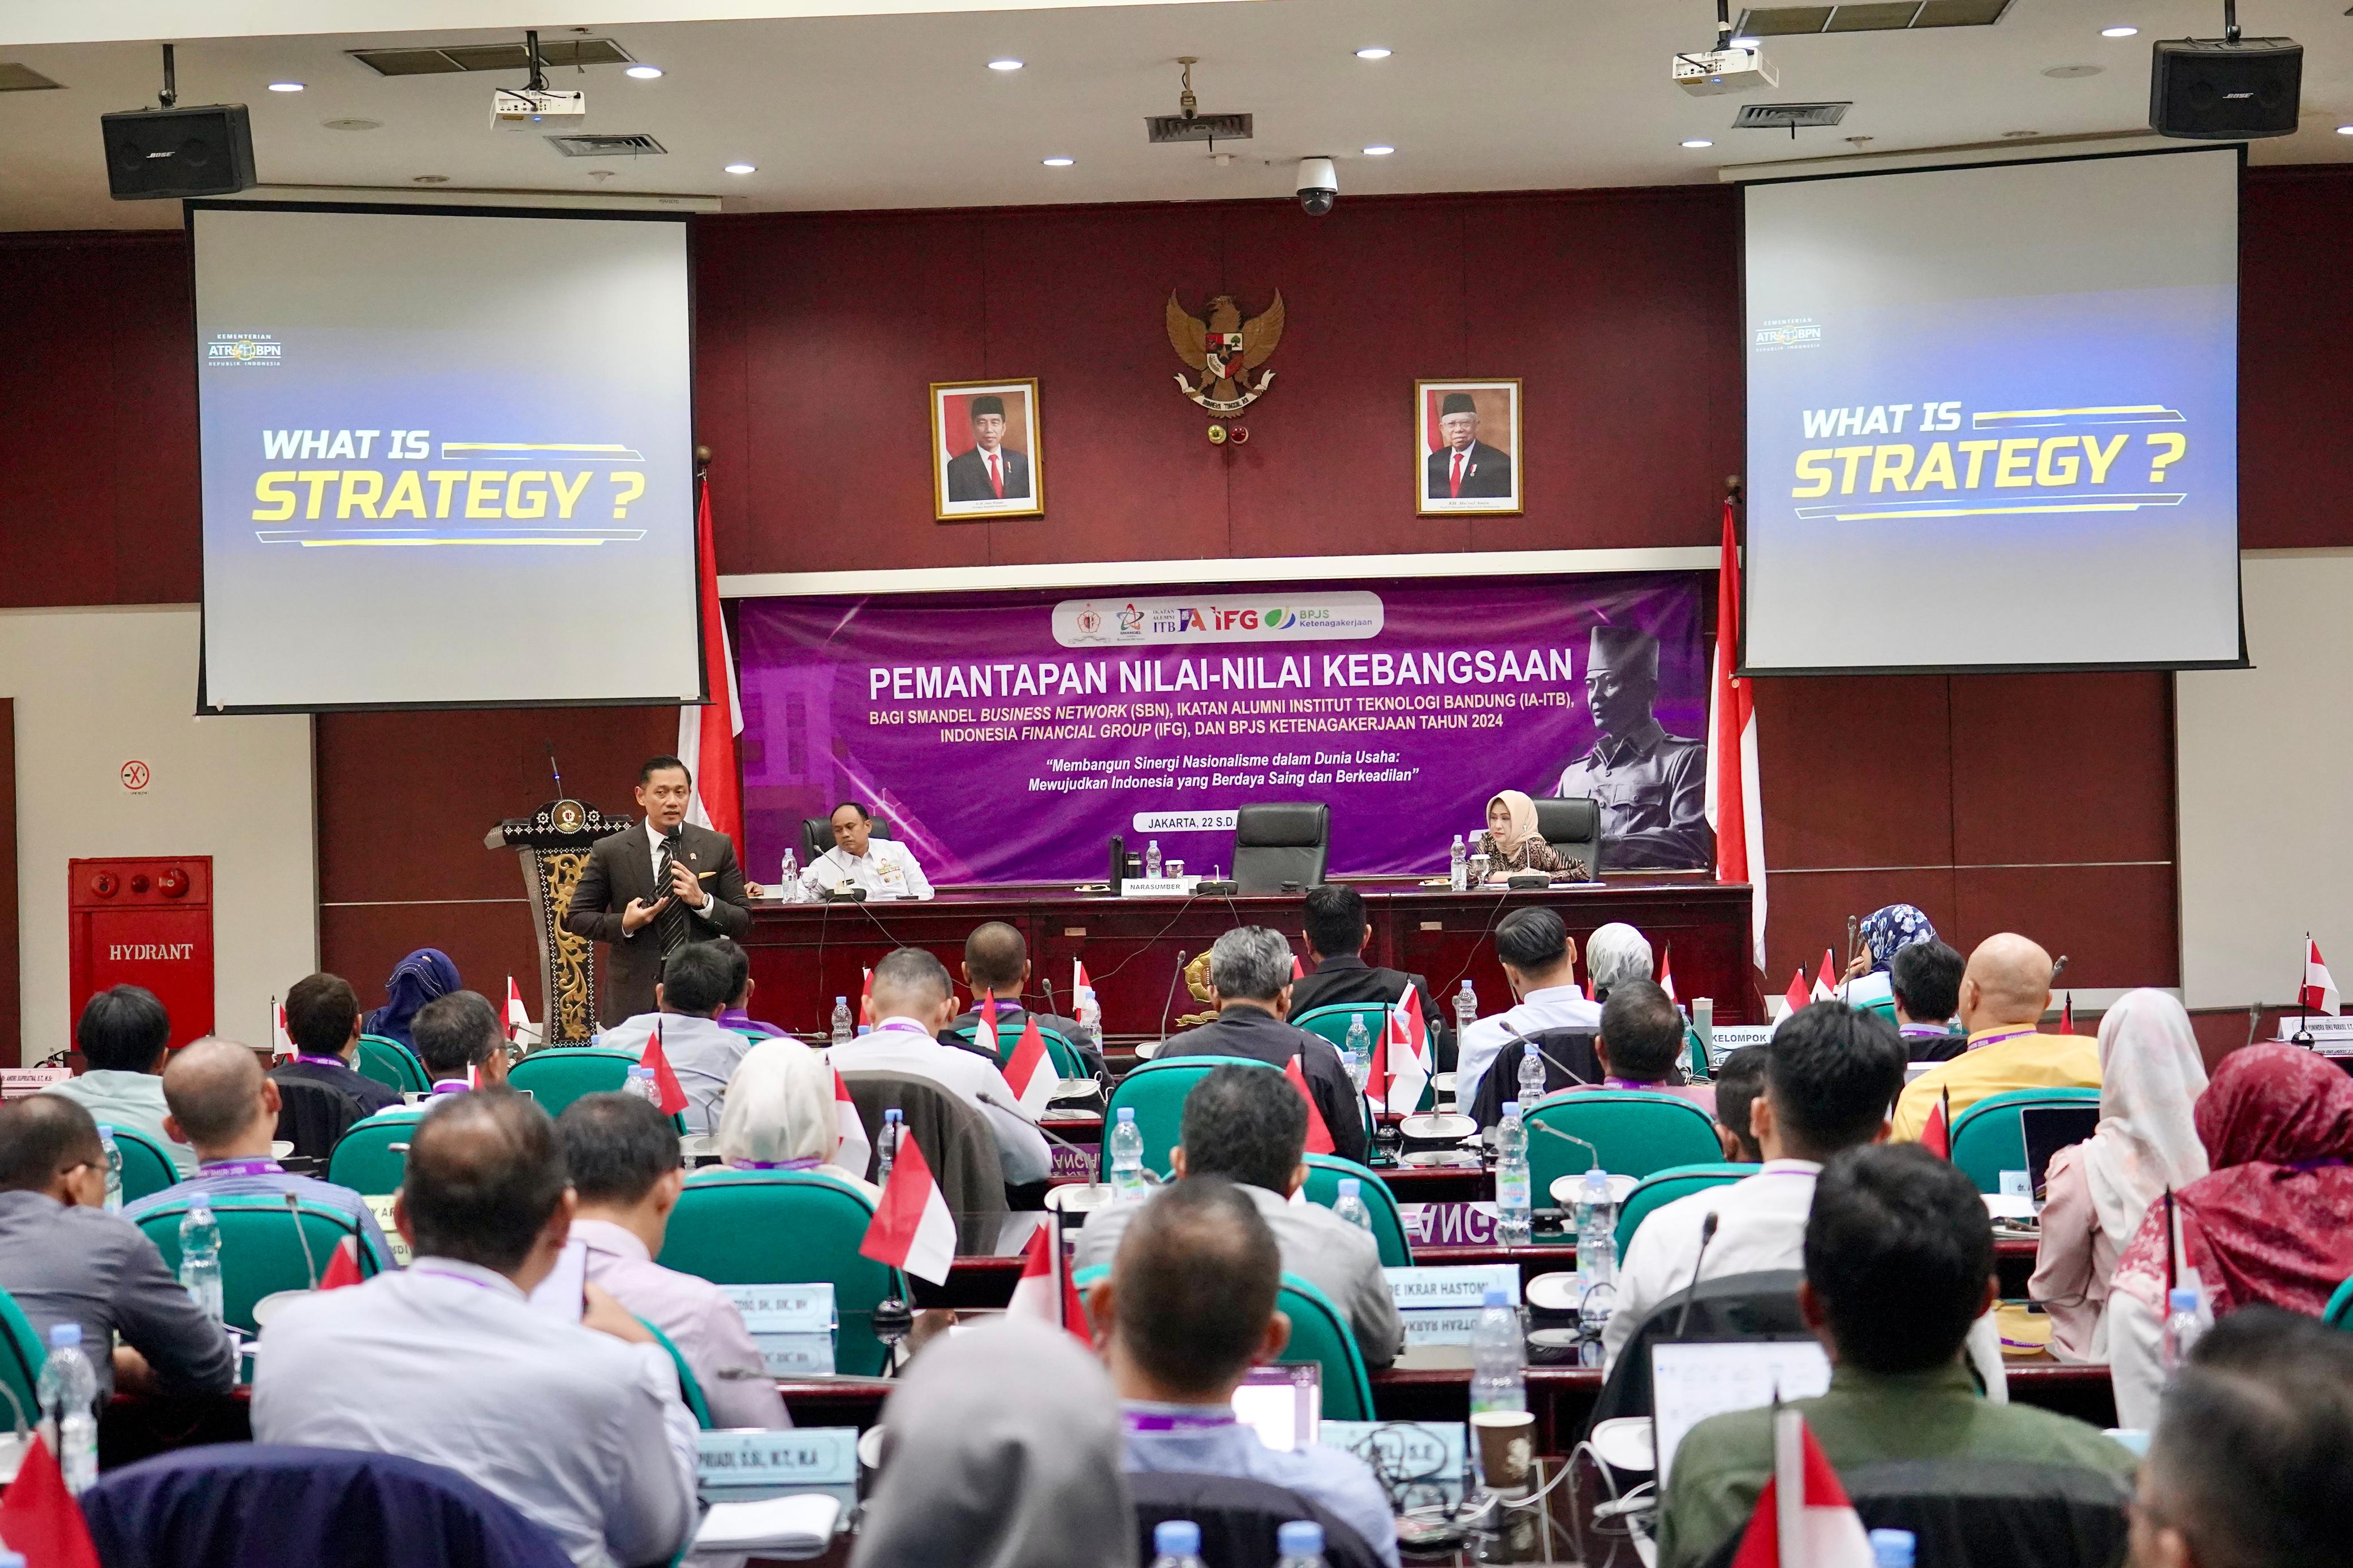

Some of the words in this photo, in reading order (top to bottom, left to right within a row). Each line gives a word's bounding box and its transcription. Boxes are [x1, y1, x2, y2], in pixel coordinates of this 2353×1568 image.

[1799, 327, 1821, 339] BPN
[256, 345, 281, 356] BPN
[1802, 404, 1912, 439] WHAT
[1919, 401, 1962, 433] IS
[262, 430, 380, 459] WHAT
[387, 430, 430, 459] IS
[1791, 433, 2131, 498] STRATEGY
[2146, 432, 2187, 483] ?
[252, 470, 593, 521] STRATEGY
[612, 471, 645, 519] ?
[1300, 609, 1330, 619] BPJS
[1300, 619, 1373, 628] Ketenagakerjaan
[1153, 621, 1176, 633] ITB
[869, 661, 1107, 700] PEMANTAPAN
[1119, 655, 1311, 693] NILAI-NILAI
[1322, 648, 1572, 687] KEBANGSAAN
[869, 711, 904, 725] BAGI
[908, 709, 976, 723] SMANDEL
[980, 707, 1051, 722] BUSINESS
[1055, 705, 1128, 720] NETWORK
[1131, 702, 1173, 719] (SBN),
[1177, 701, 1227, 716] IKATAN
[1231, 699, 1286, 715] ALUMNI
[1290, 698, 1353, 713] INSTITUT
[1356, 696, 1440, 711] TEKNOLOGI
[1444, 693, 1516, 709] BANDUNG
[1520, 692, 1575, 710] (IA-ITB),
[941, 727, 1018, 742] INDONESIA
[1022, 725, 1096, 740] FINANCIAL
[1100, 723, 1152, 738] GROUP
[1155, 722, 1191, 740] (IFG),
[1195, 720, 1226, 735] DAN
[1229, 719, 1266, 735] BPJS
[1269, 716, 1416, 733] KETENAGAKERJAAN
[1419, 714, 1468, 730] TAHUN
[1471, 713, 1503, 728] 2024
[1046, 758, 1130, 774] “Membangun
[1134, 755, 1180, 771] Sinergi
[1183, 753, 1269, 768] Nasionalisme
[1272, 752, 1311, 766] dalam
[1315, 751, 1352, 764] Dunia
[1355, 750, 1400, 764] Usaha:
[1028, 776, 1108, 793] Mewujudkan
[1111, 775, 1174, 789] Indonesia
[1176, 775, 1209, 791] yang
[1212, 772, 1265, 788] Berdaya
[1268, 770, 1305, 787] Saing
[1308, 770, 1333, 784] dan
[1335, 767, 1419, 783] Berkeadilan”
[1148, 818, 1199, 830] JAKARTA,
[1202, 817, 1213, 827] 22
[1216, 817, 1236, 827] S.D.
[109, 944, 193, 960] HYDRANT
[1404, 1283, 1437, 1295] IKRAR
